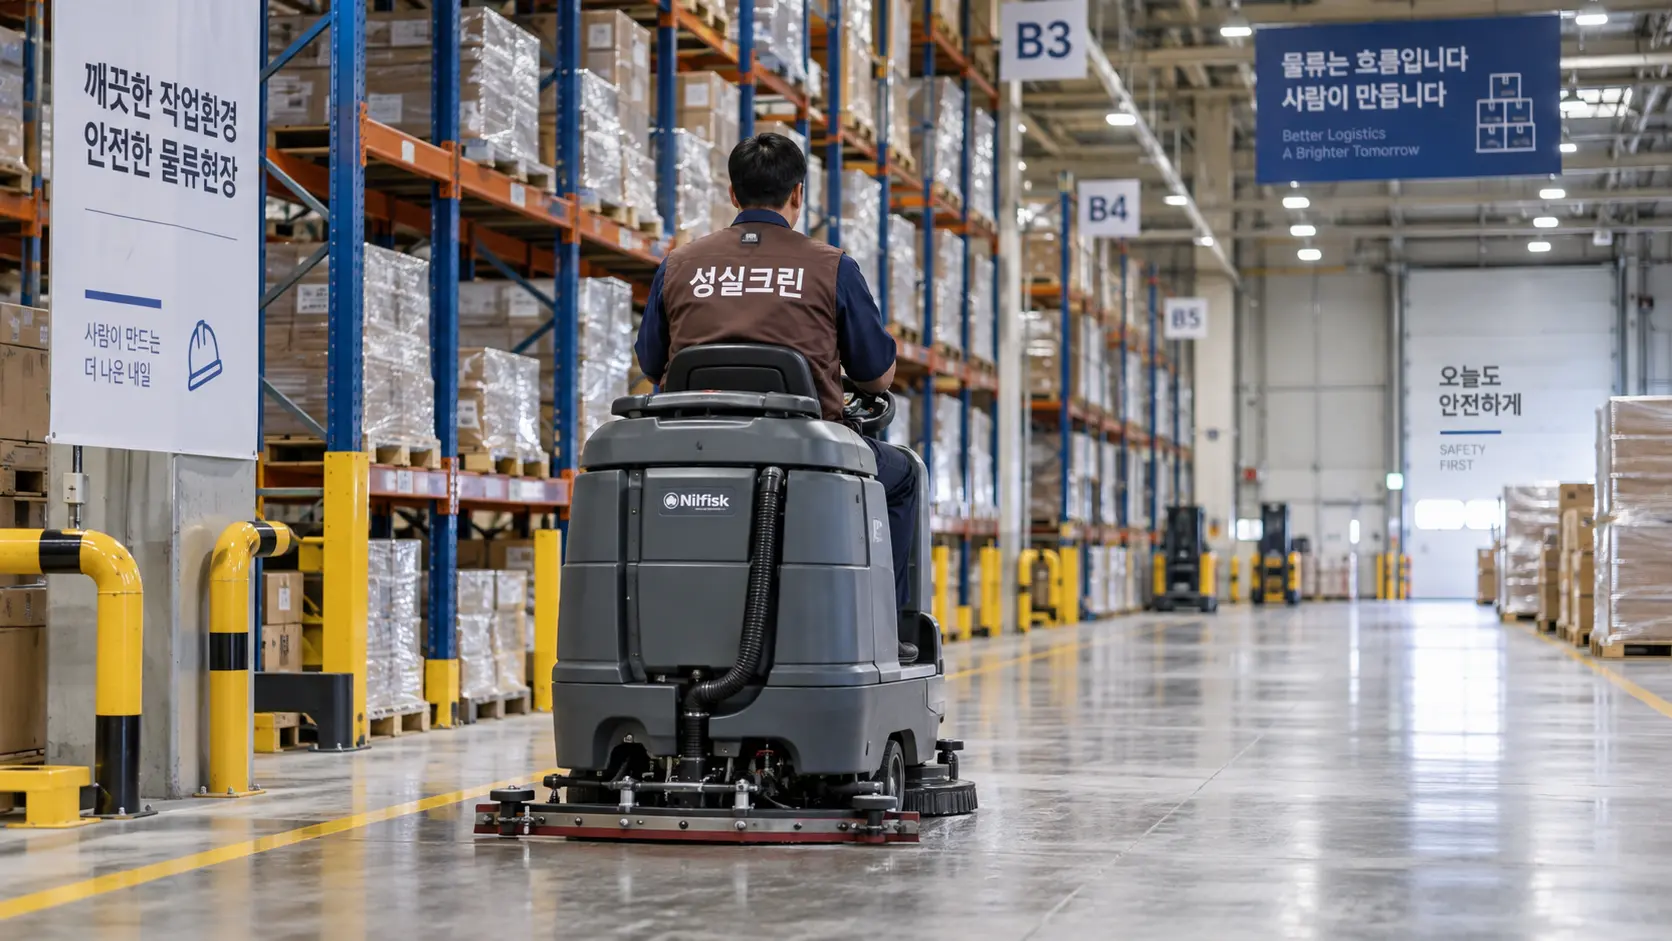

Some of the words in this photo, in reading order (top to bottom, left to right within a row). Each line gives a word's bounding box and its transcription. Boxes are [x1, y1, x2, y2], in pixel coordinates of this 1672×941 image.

[1017, 20, 1072, 59] B3
[1281, 51, 1349, 78] 물류는
[1355, 46, 1469, 75] 흐름입니다
[84, 62, 153, 120] 깨끗한
[159, 81, 237, 143] 작업환경
[1281, 83, 1349, 112] 사람이
[1355, 80, 1447, 110] 만듭니다
[1282, 129, 1323, 142] Better
[1328, 127, 1386, 143] Logistics
[84, 121, 152, 178] 안전한
[159, 138, 238, 199] 물류현장
[1282, 147, 1293, 160] A
[1296, 145, 1349, 161] Brighter
[1353, 144, 1420, 158] Tomorrow
[1089, 195, 1128, 222] B4
[689, 266, 804, 299] 성실크린
[1171, 308, 1201, 329] B5
[84, 321, 122, 351] 사람이
[126, 326, 161, 354] 만드는
[84, 356, 97, 382] 더
[101, 358, 124, 385] 나운
[128, 361, 151, 388] 내일
[1439, 365, 1502, 389] 오늘도
[1439, 393, 1522, 417] 안전하게
[1439, 443, 1486, 456] SAFETY
[1439, 459, 1475, 472] FIRST
[680, 493, 730, 507] Nilfisk
